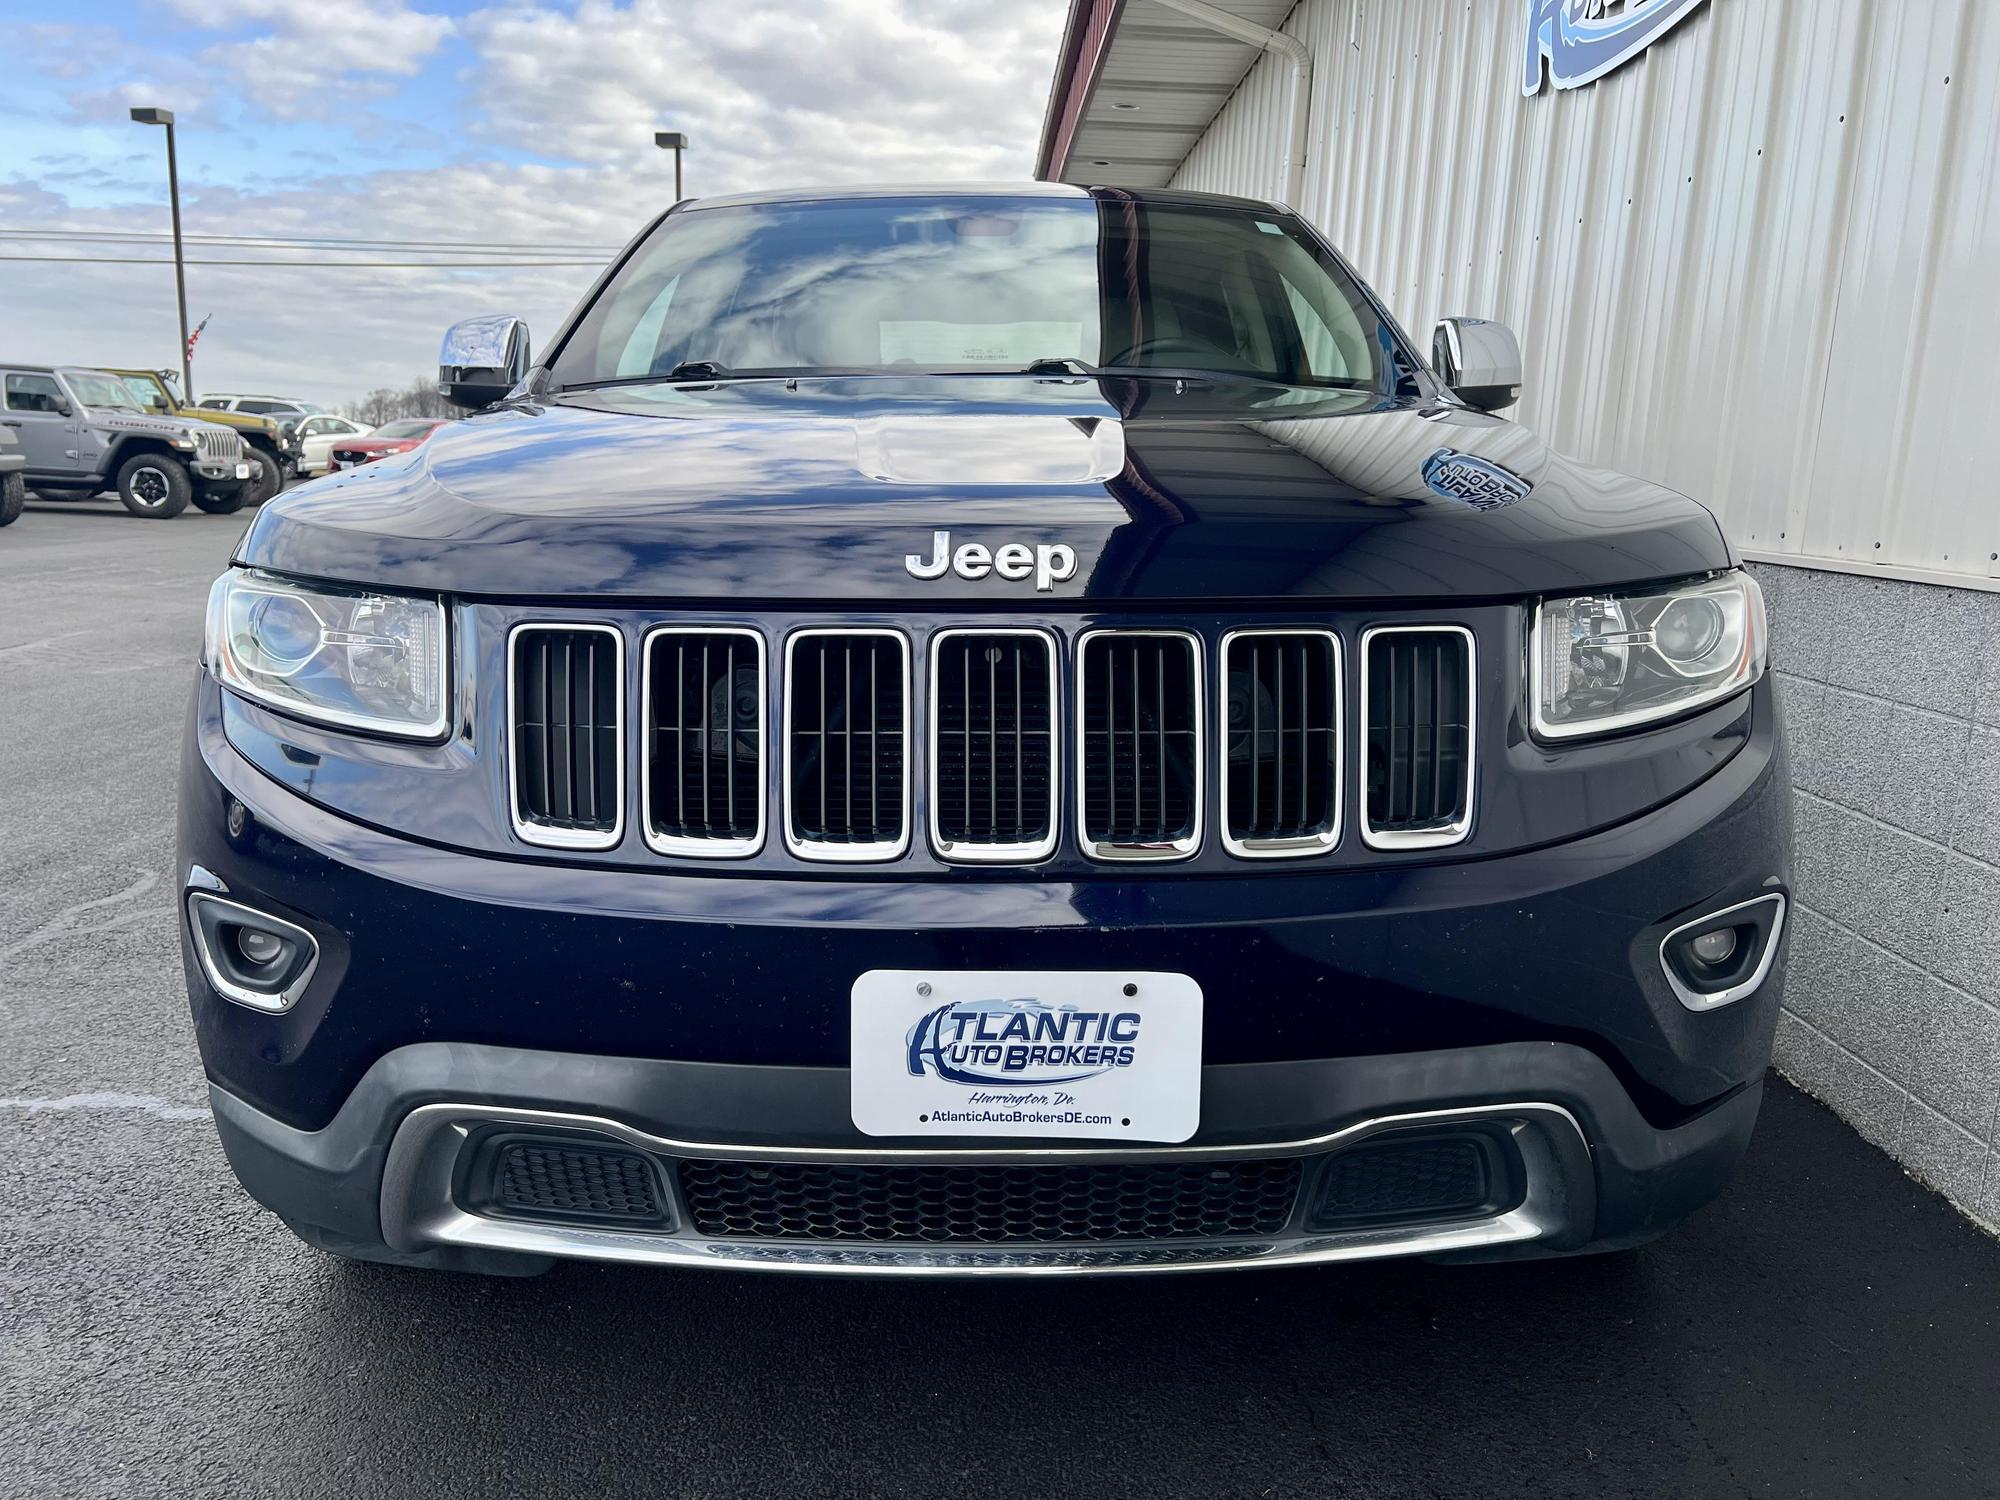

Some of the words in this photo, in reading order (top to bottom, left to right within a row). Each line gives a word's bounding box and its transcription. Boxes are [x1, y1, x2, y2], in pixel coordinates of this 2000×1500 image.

[905, 531, 1077, 592] Jeep
[910, 1002, 1141, 1074] ATLANTIC
[931, 1110, 1112, 1125] AtlanticAutoBrokersDE.com
